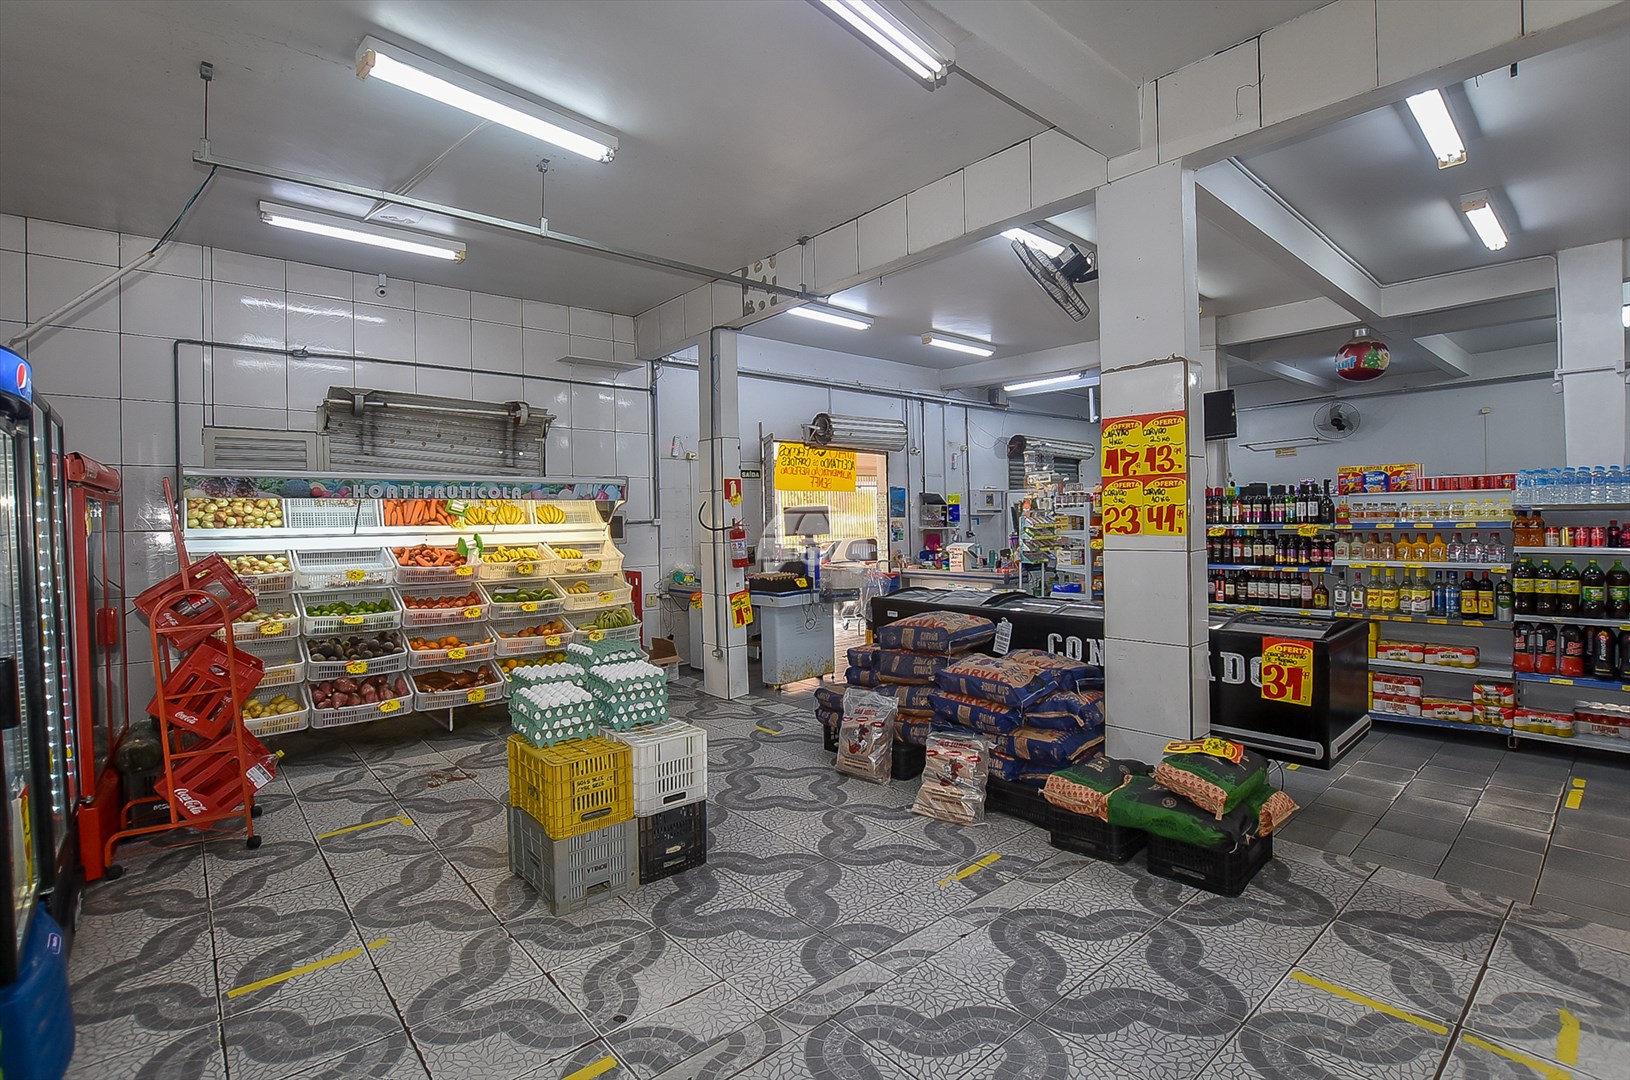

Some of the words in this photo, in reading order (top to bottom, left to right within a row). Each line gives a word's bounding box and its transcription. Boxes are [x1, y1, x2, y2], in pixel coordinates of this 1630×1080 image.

[1153, 417, 1183, 426] OFERTA
[1112, 422, 1140, 430] OFERTA
[741, 470, 760, 478] SAÍDA
[1112, 481, 1141, 489] OFERTA
[1153, 480, 1184, 488] OFERTA
[352, 482, 522, 500] HORTIFRUTÍCOLA
[1275, 645, 1310, 654] OFERTA
